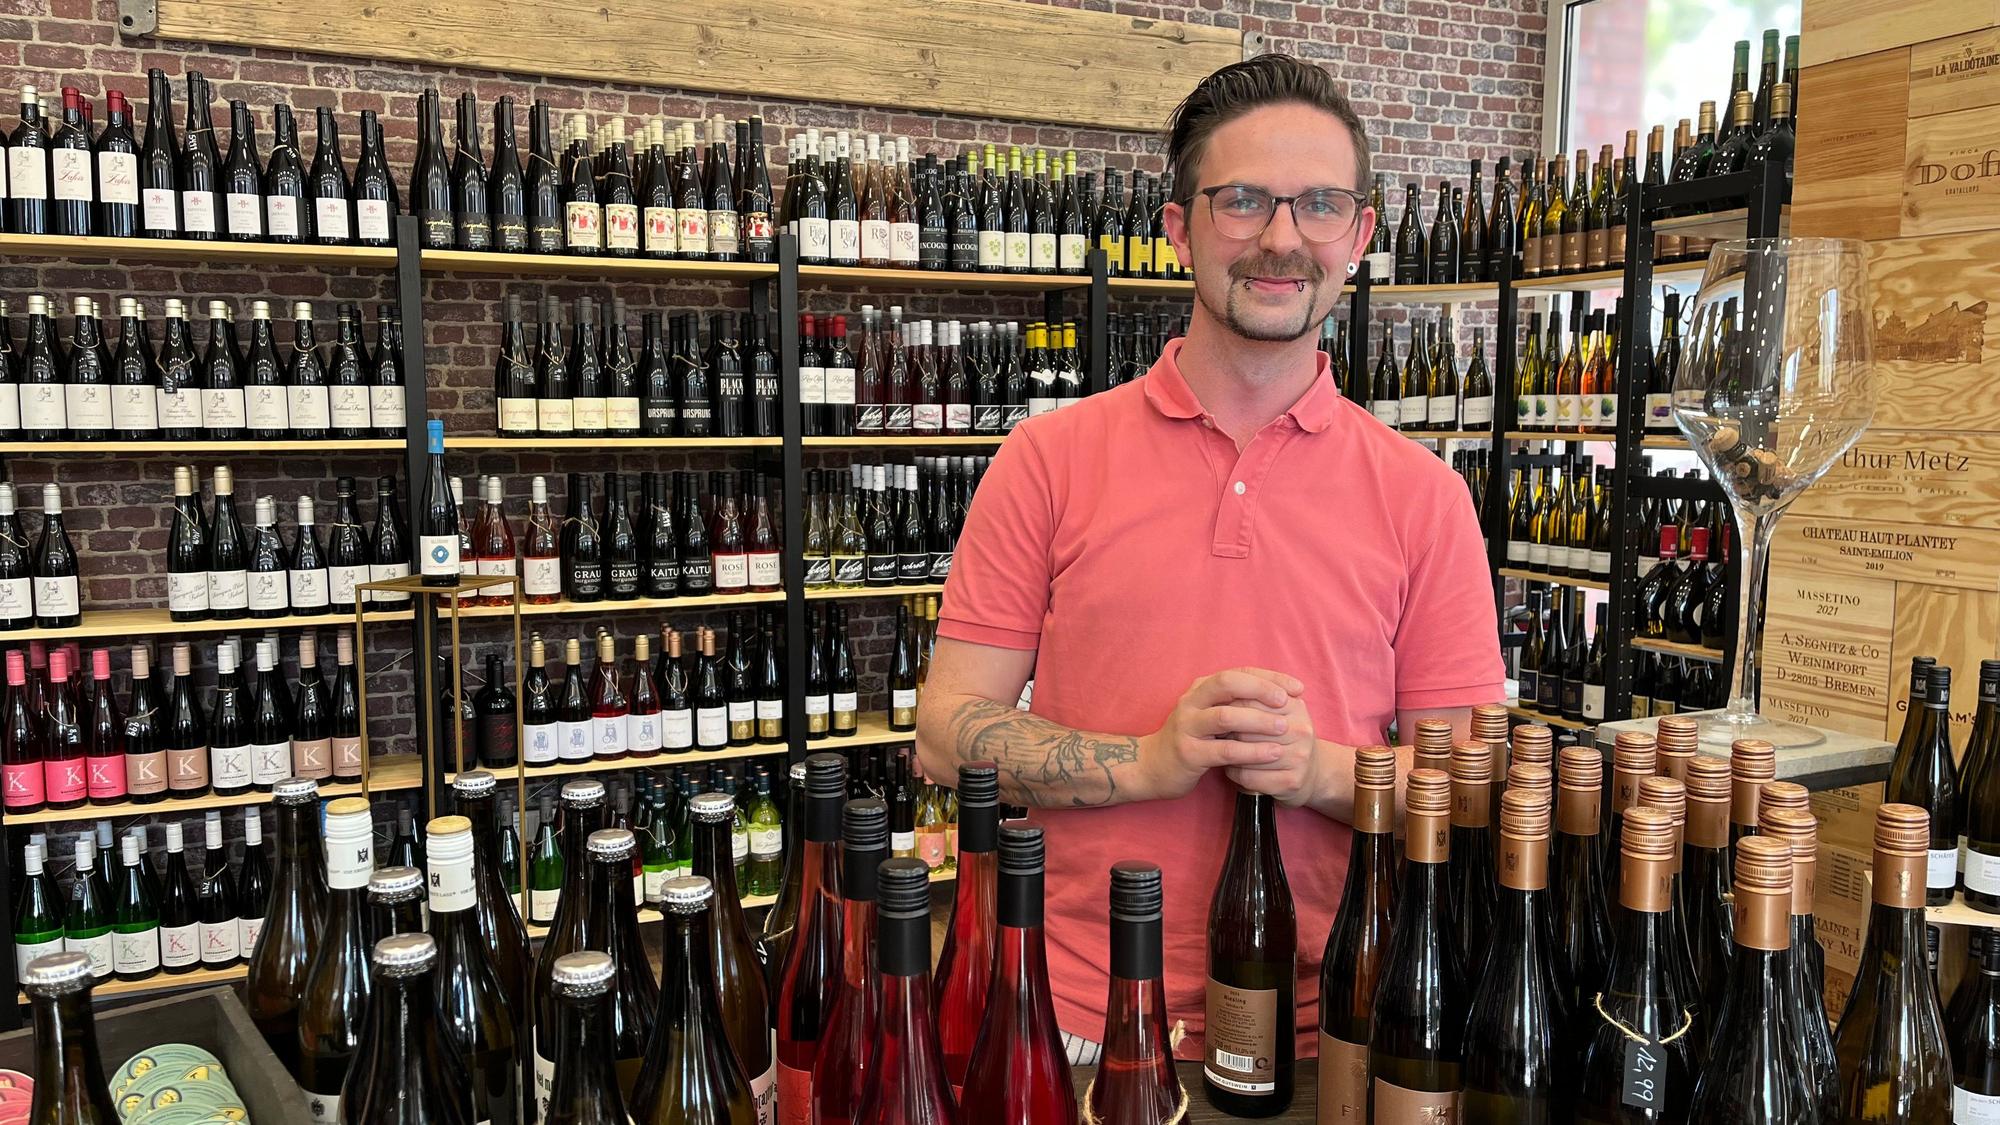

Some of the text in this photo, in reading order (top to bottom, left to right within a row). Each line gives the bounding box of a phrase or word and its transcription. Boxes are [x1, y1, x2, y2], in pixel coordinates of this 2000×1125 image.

[1935, 65, 1946, 77] LA
[1949, 148, 1979, 156] FINCA
[1904, 449, 1970, 472] Metz
[1803, 527, 1957, 550] CHATEAU HAUT PLANTEY
[1839, 546, 1913, 561] SAINT-EMILION
[574, 570, 601, 578] GRAU
[611, 569, 638, 578] GRAU
[1865, 562, 1884, 571] 2019
[1797, 589, 1861, 606] MASSETINO
[1816, 605, 1839, 616] 2021
[1848, 646, 1857, 656] &
[1788, 651, 1868, 677] WEINIMPORT
[1825, 676, 1876, 697] BREMEN
[1768, 698, 1830, 719] MASSETINO
[1788, 714, 1809, 726] 2021
[178, 756, 198, 776] K
[223, 754, 242, 773] K
[262, 750, 281, 770] K
[303, 747, 322, 766] K
[65, 765, 83, 786] K
[92, 764, 111, 783] K
[138, 759, 158, 780] K
[8, 772, 28, 792] K
[168, 933, 191, 953] K
[208, 929, 225, 949] K
[1223, 994, 1247, 1005] Riesling
